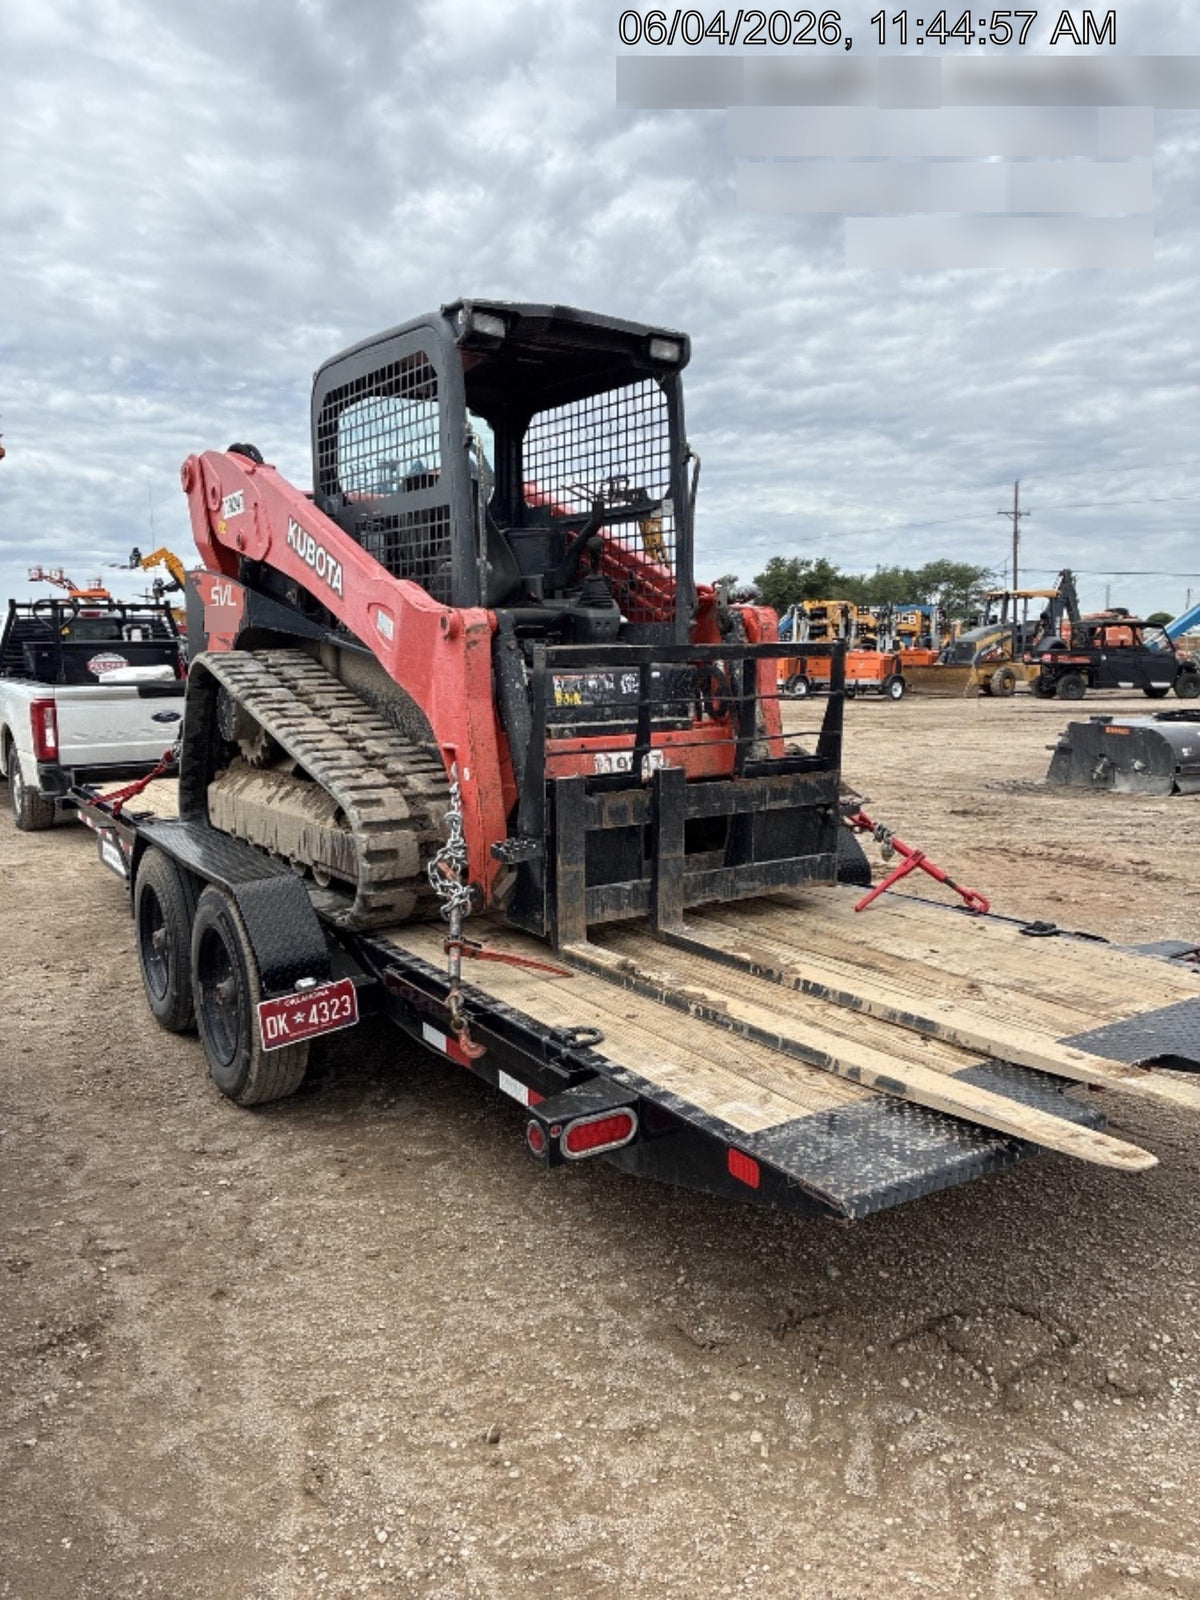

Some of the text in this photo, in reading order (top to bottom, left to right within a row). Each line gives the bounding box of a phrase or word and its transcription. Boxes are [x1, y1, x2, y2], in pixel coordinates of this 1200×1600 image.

[287, 516, 343, 596] KUBOTA
[210, 584, 237, 606] SVL
[309, 995, 351, 1024] 4323
